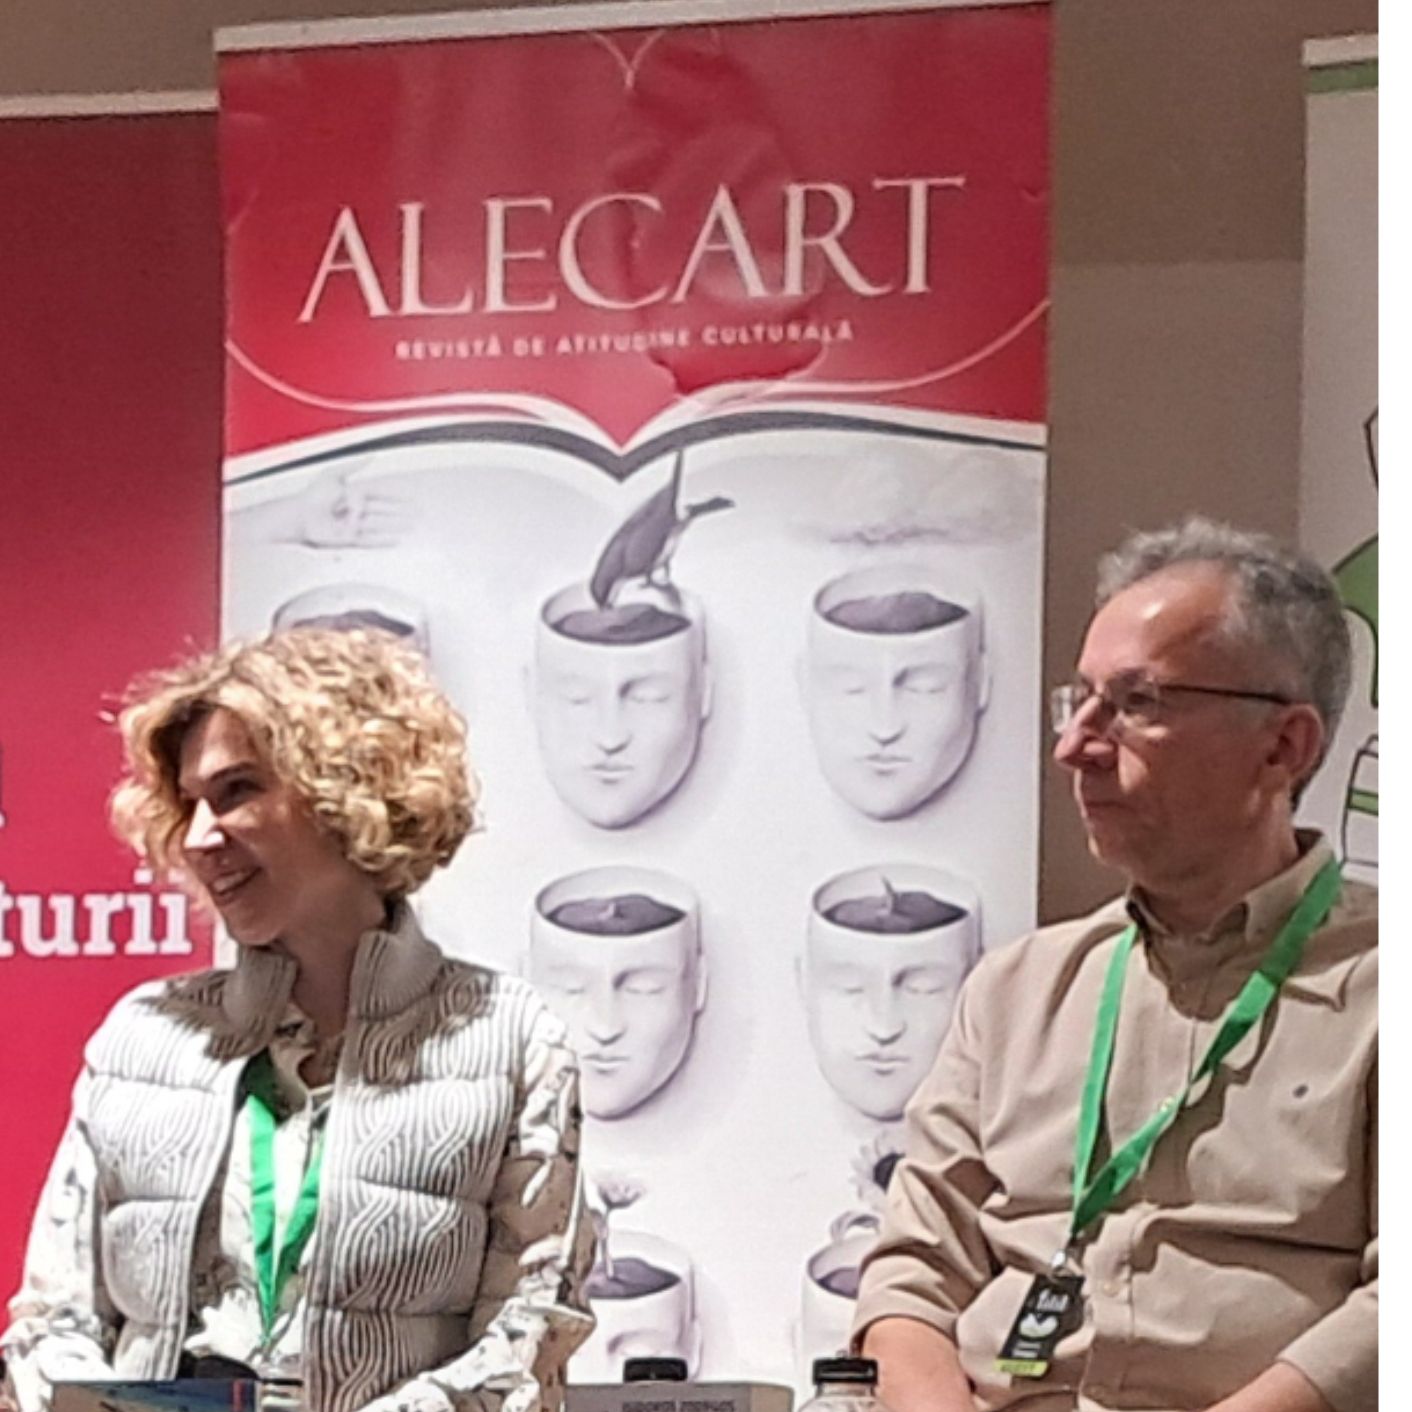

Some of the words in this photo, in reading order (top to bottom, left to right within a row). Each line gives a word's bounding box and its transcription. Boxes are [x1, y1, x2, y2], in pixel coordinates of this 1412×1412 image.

[297, 175, 967, 322] ALECART
[396, 336, 501, 360] REVISTĂ
[513, 335, 545, 356] DE
[556, 327, 690, 355] ATITUDINE
[702, 320, 854, 346] CULTURALĂ
